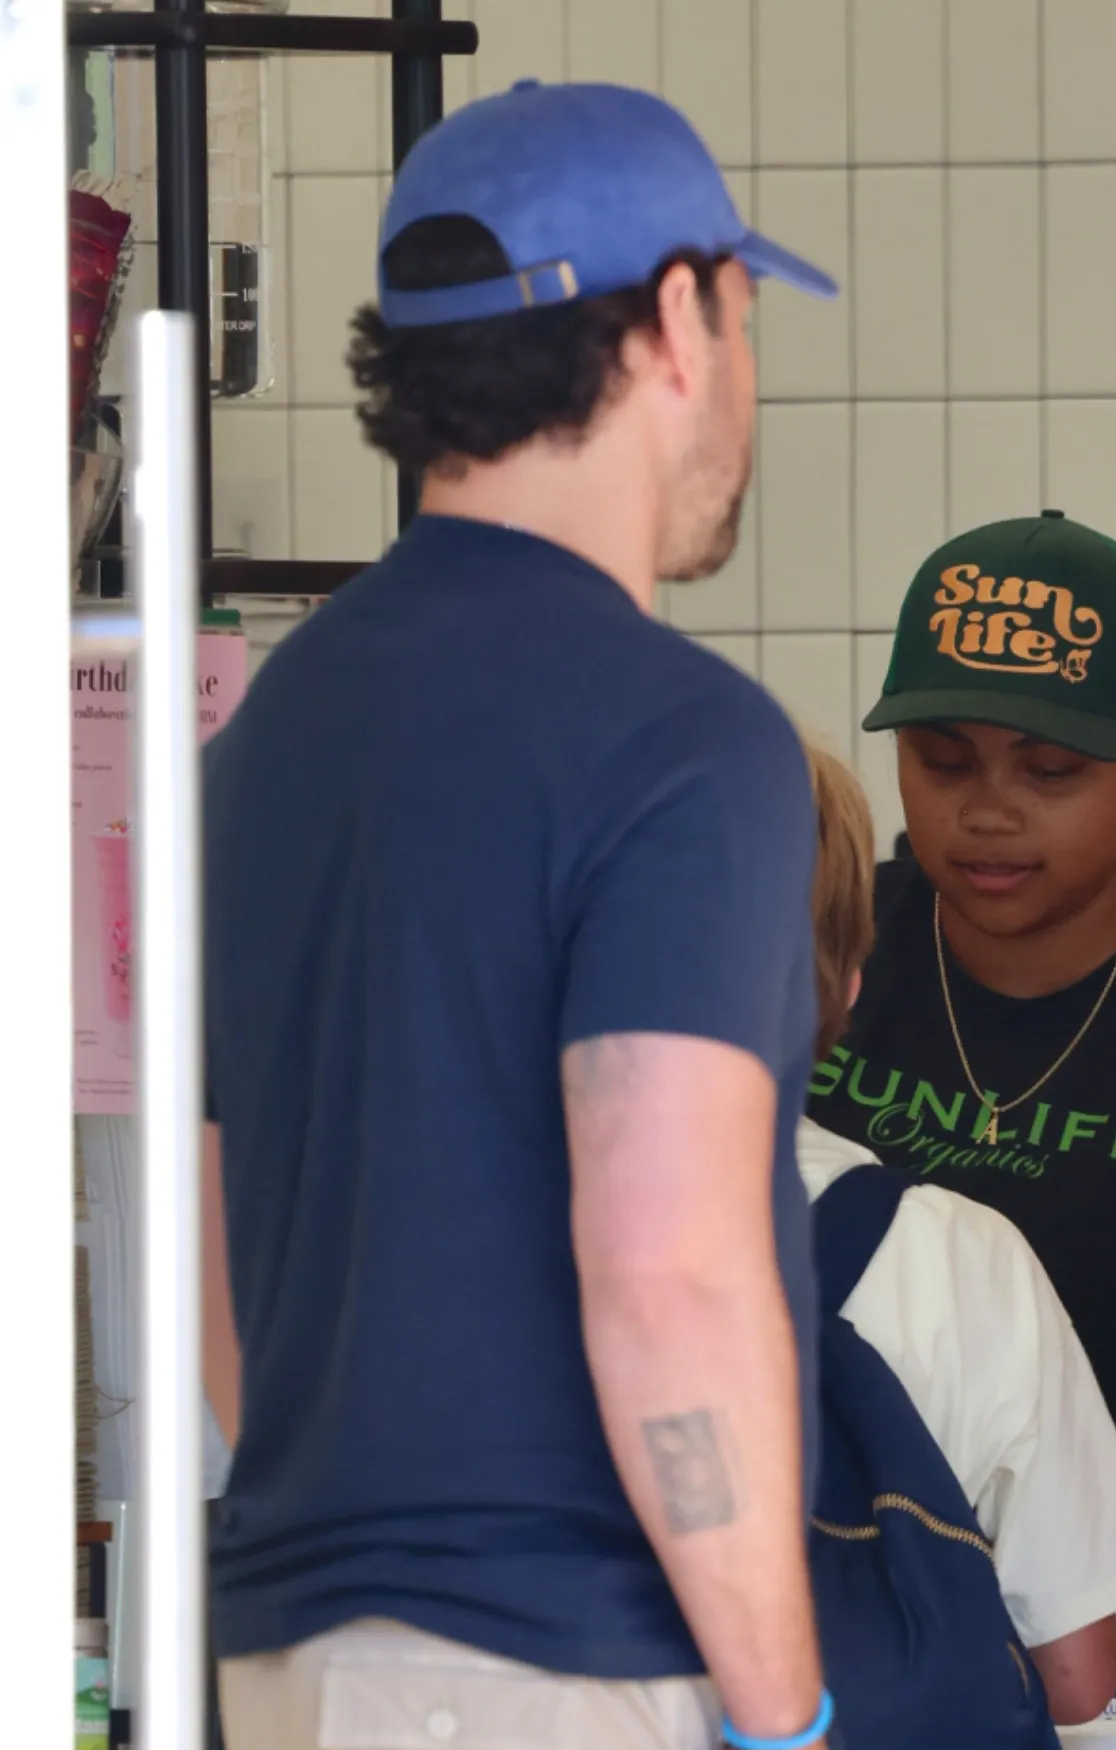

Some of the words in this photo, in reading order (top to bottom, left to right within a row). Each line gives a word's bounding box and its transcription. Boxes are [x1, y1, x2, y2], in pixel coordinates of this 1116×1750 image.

[929, 607, 1060, 674] Life
[934, 563, 1103, 646] Sun
[866, 1102, 1040, 1178] Organics
